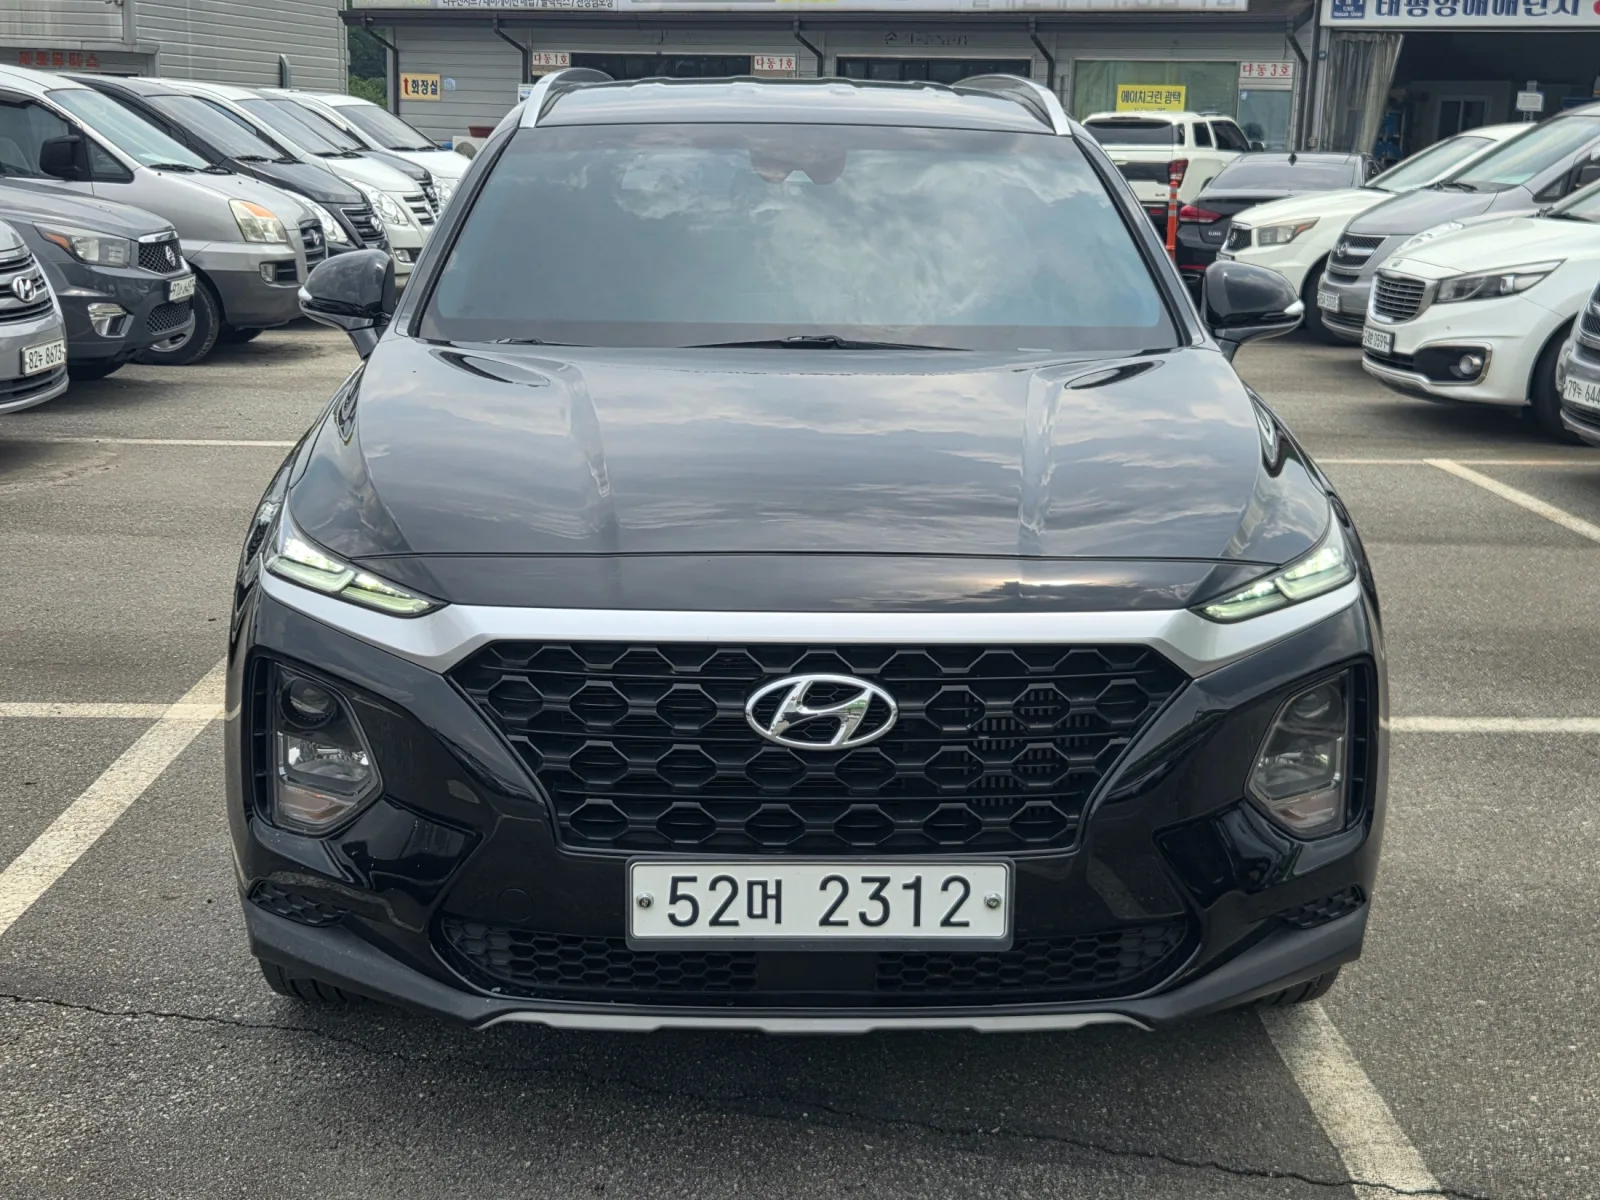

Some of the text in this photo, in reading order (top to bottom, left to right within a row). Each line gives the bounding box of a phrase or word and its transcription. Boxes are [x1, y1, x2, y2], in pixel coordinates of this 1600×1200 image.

[411, 79, 438, 95] 화장실
[1121, 90, 1181, 104] 에이치크린 광택
[667, 874, 972, 928] 52머 2312
